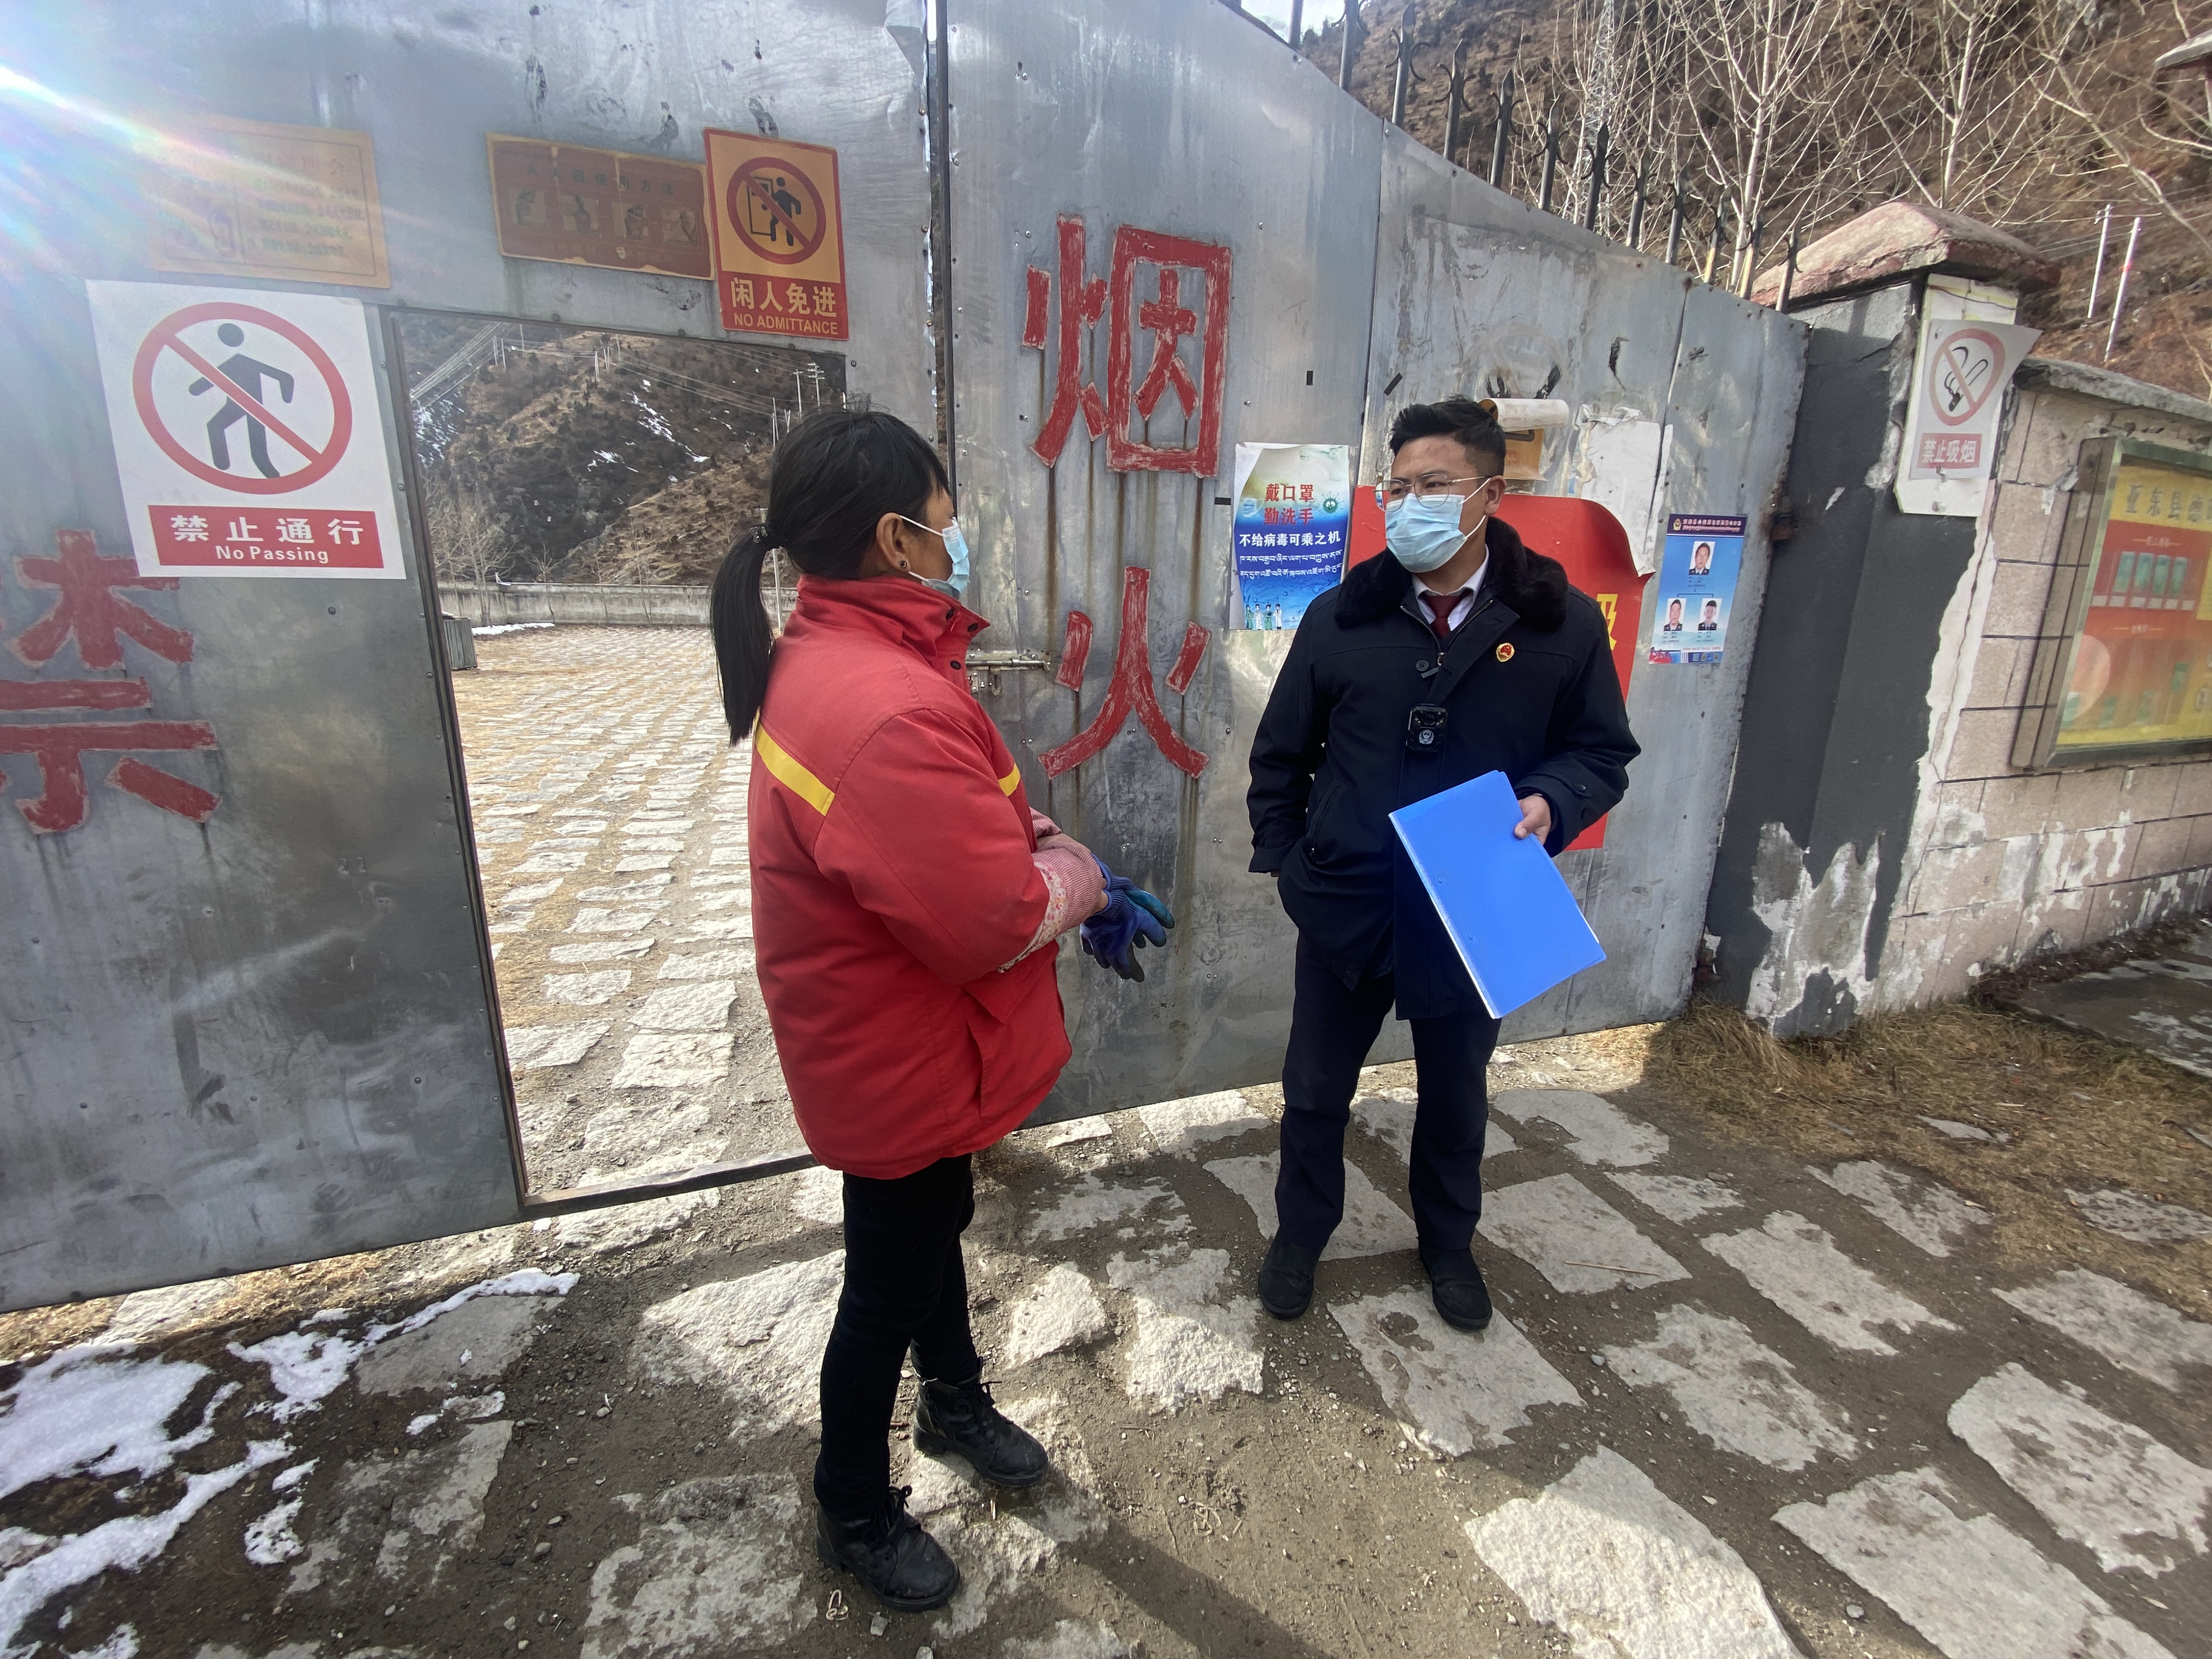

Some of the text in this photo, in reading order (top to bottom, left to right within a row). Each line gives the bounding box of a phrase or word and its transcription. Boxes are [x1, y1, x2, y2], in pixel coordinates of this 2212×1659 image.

[526, 162, 675, 196] 灭火器使用方法
[730, 276, 837, 318] 闲人免进
[733, 312, 838, 335] NO ADMITTANCE
[1921, 438, 1977, 465] 禁止吸烟
[1265, 484, 1313, 501] 戴口罩
[1264, 508, 1313, 525] 勤洗手
[170, 515, 364, 546] 禁止通行
[1239, 531, 1341, 548] 不给病毒可乘之机
[215, 545, 329, 565] No Passing
